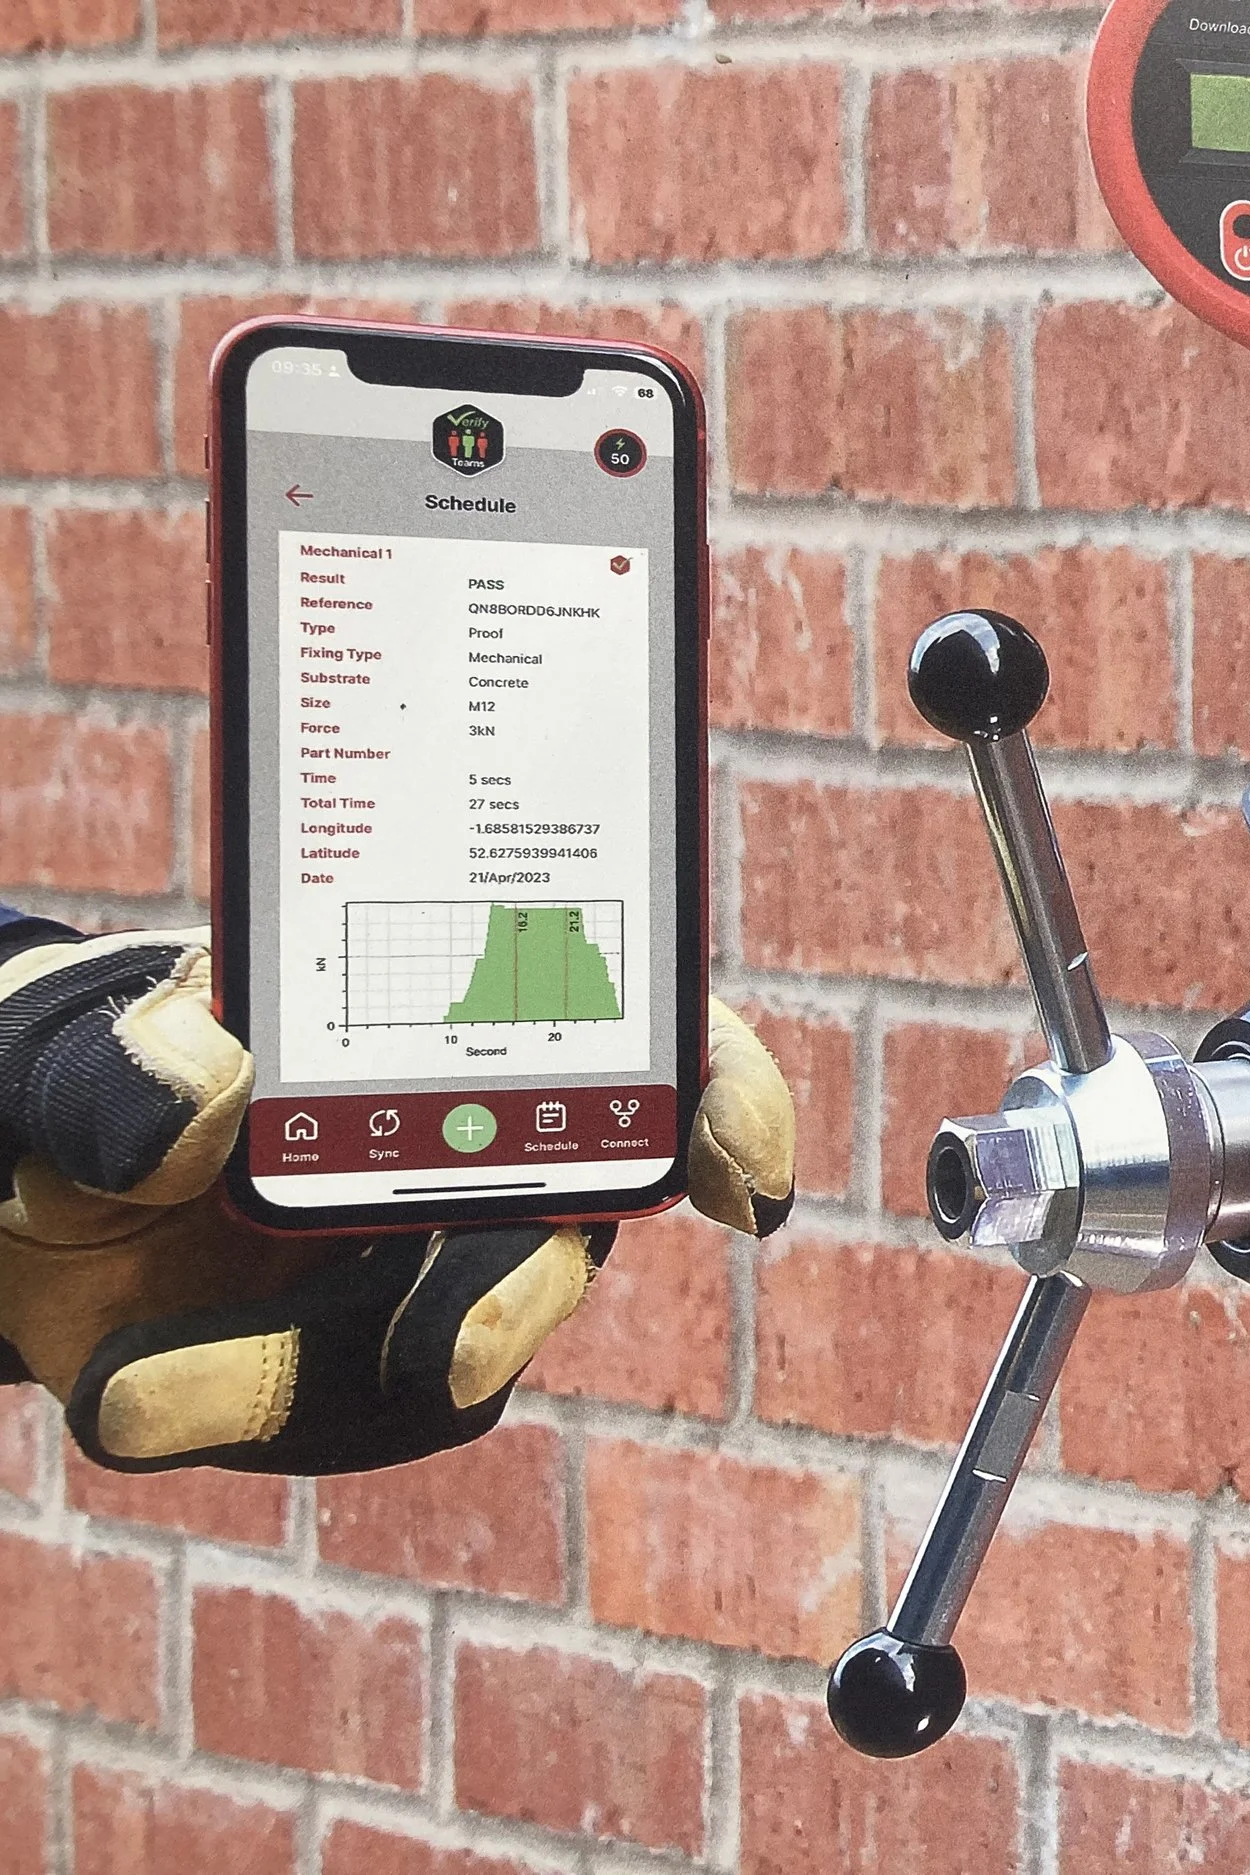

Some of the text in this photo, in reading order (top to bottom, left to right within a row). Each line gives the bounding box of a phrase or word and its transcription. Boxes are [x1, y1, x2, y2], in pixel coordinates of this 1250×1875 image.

[271, 360, 322, 376] 09:35
[638, 388, 654, 398] 68
[451, 457, 486, 468] Teams
[611, 453, 630, 465] 50
[425, 494, 517, 514] Schedule
[300, 544, 392, 560] Mechanical 1
[300, 571, 345, 585] Result
[468, 578, 505, 591] PASS
[300, 596, 373, 610] Reference
[299, 621, 336, 636] Type
[468, 627, 504, 639] Proof
[300, 646, 382, 663] Fixing Type
[468, 651, 543, 665] Mechanical
[300, 672, 371, 685] Substrate
[468, 676, 529, 689] Concrete
[300, 696, 331, 709] Size
[468, 700, 496, 712] M12
[300, 722, 341, 734] Force
[469, 724, 495, 737] 3kN
[300, 747, 391, 760] Part Number
[299, 772, 337, 784] Time
[469, 774, 512, 786] 5 secs
[300, 797, 376, 809] Total Time
[469, 798, 520, 810] 27 secs
[301, 822, 372, 837] Longitude
[301, 847, 361, 859] Latitude
[469, 847, 598, 859] 52.6275939941406
[301, 872, 334, 884] Date
[469, 871, 551, 885] 21/Apr/2023
[569, 911, 579, 932] 21.2
[315, 957, 327, 972] kN
[326, 1021, 336, 1031] 0
[341, 1037, 350, 1048] 0
[444, 1035, 458, 1045] 10
[547, 1032, 562, 1042] 20
[465, 1046, 507, 1057] Second
[524, 1140, 579, 1152] Schedule
[600, 1138, 649, 1149] Connect
[282, 1153, 320, 1163] Home
[369, 1148, 400, 1161] Sync
